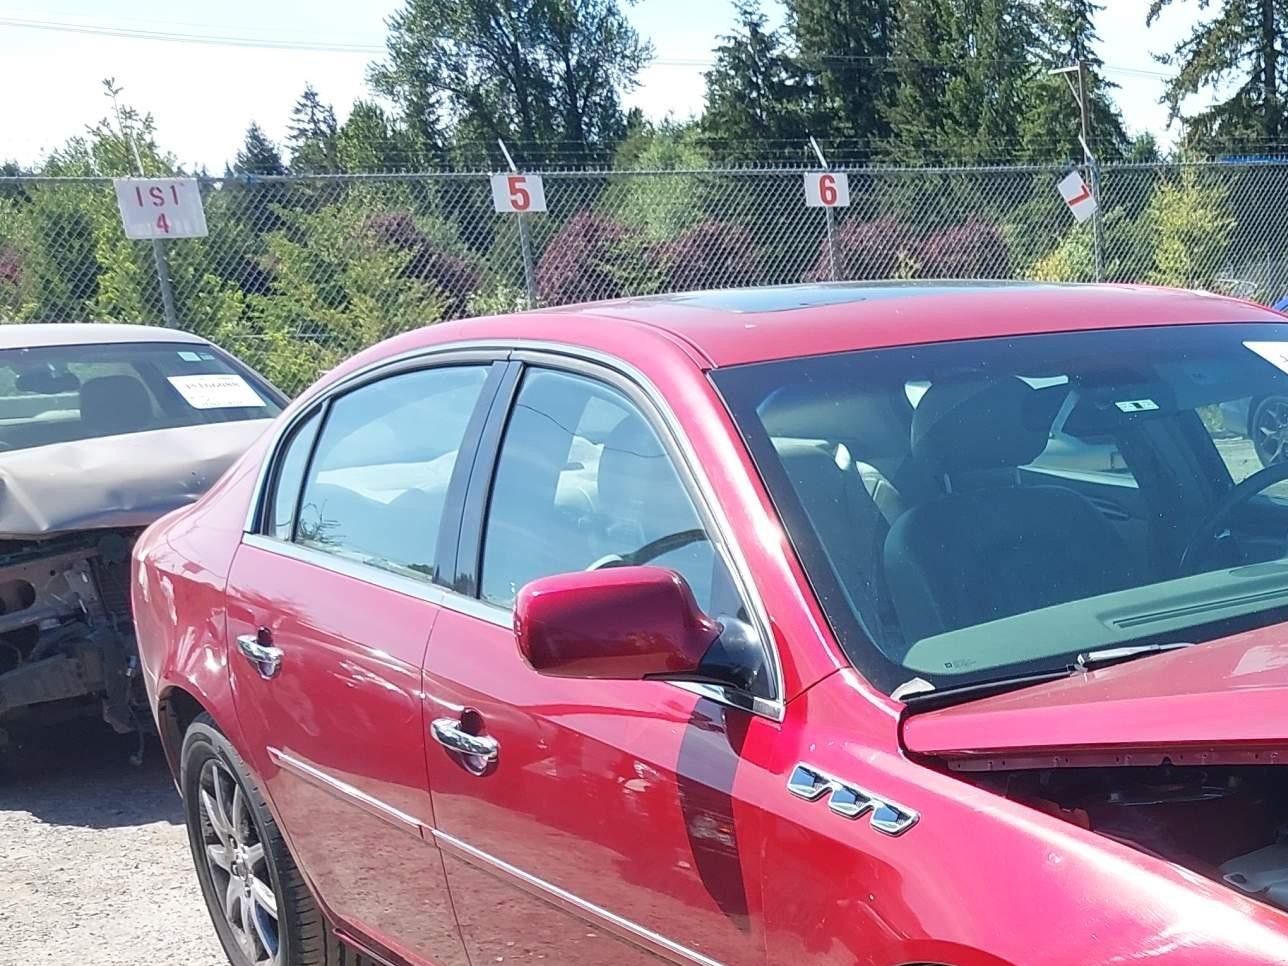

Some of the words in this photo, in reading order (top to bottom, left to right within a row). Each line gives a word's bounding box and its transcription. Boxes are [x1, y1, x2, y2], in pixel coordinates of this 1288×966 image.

[508, 177, 531, 211] 5
[818, 174, 838, 205] 6
[156, 213, 170, 233] 4
